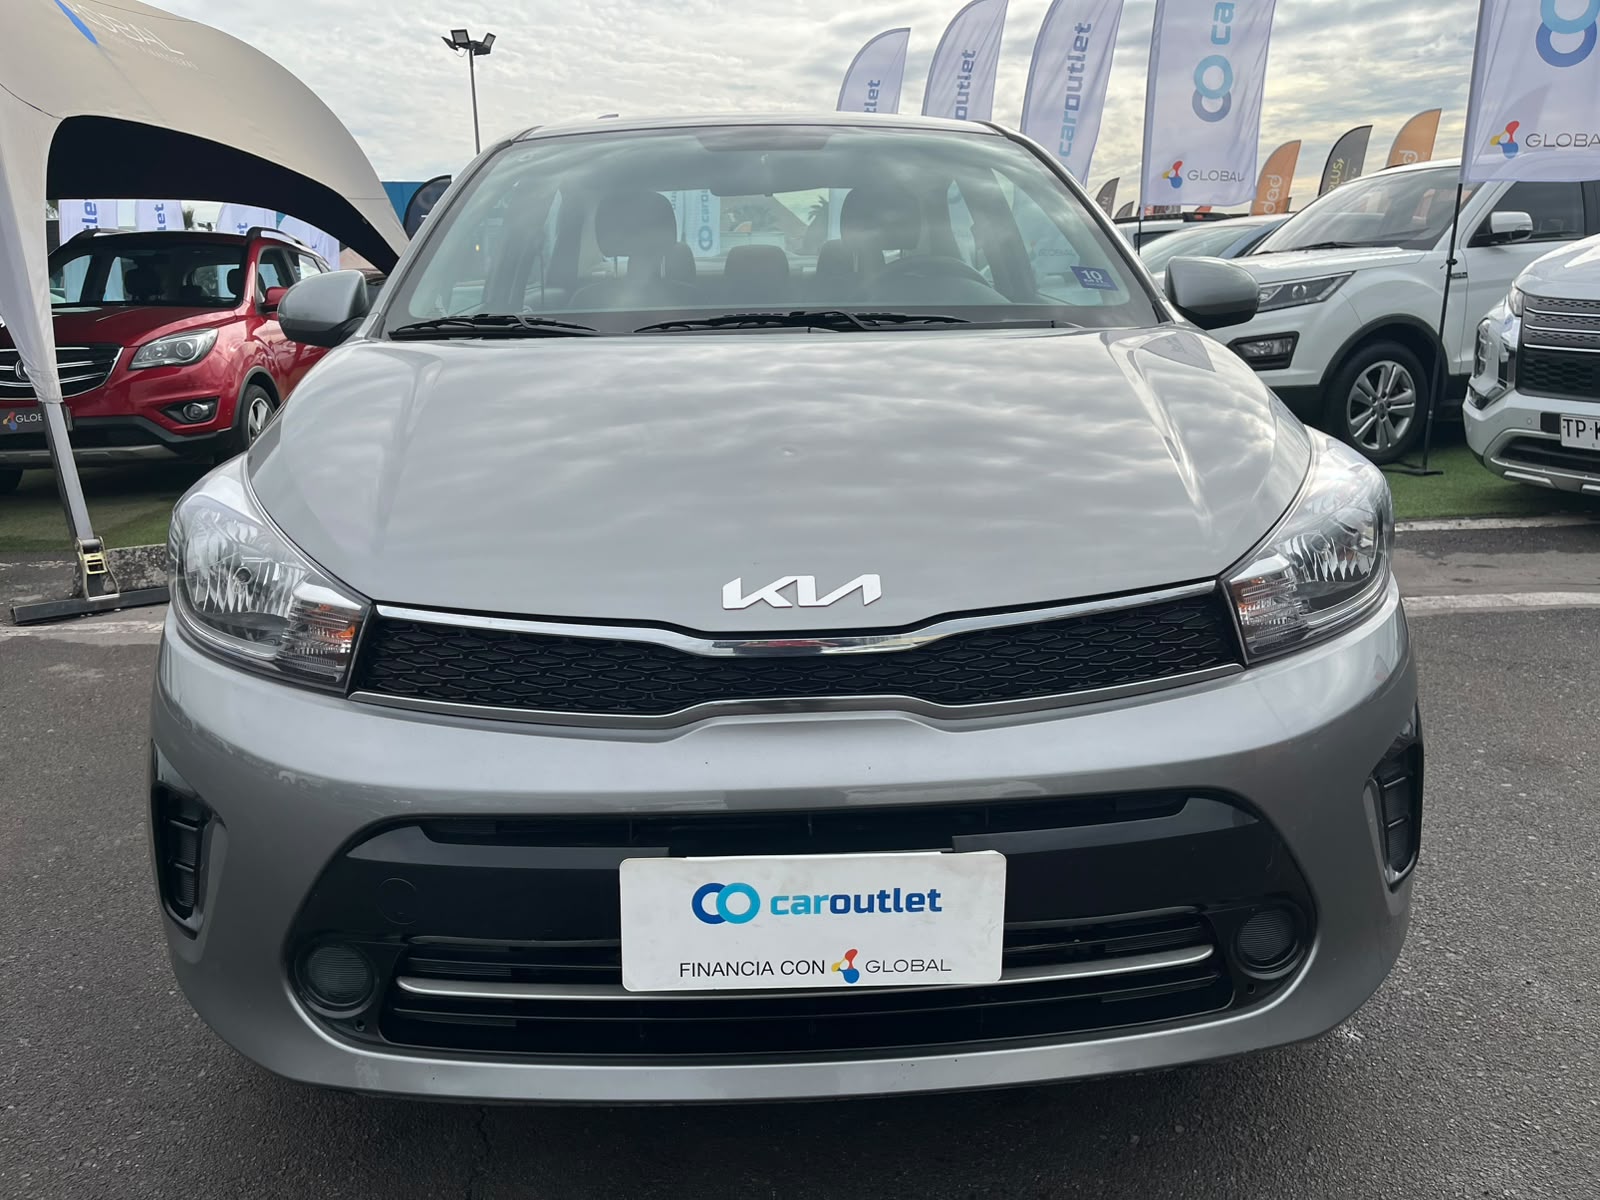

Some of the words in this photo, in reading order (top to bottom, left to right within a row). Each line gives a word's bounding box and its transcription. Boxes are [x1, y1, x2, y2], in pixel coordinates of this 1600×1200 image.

[954, 49, 977, 120] outlet
[1058, 22, 1092, 158] caroutlet
[1187, 169, 1245, 183] GLOBAL
[722, 573, 882, 610] KIA
[769, 887, 943, 917] caroutlet
[679, 960, 773, 978] FINANCIA
[780, 959, 826, 976] CON
[864, 958, 952, 974] GLOBAL
